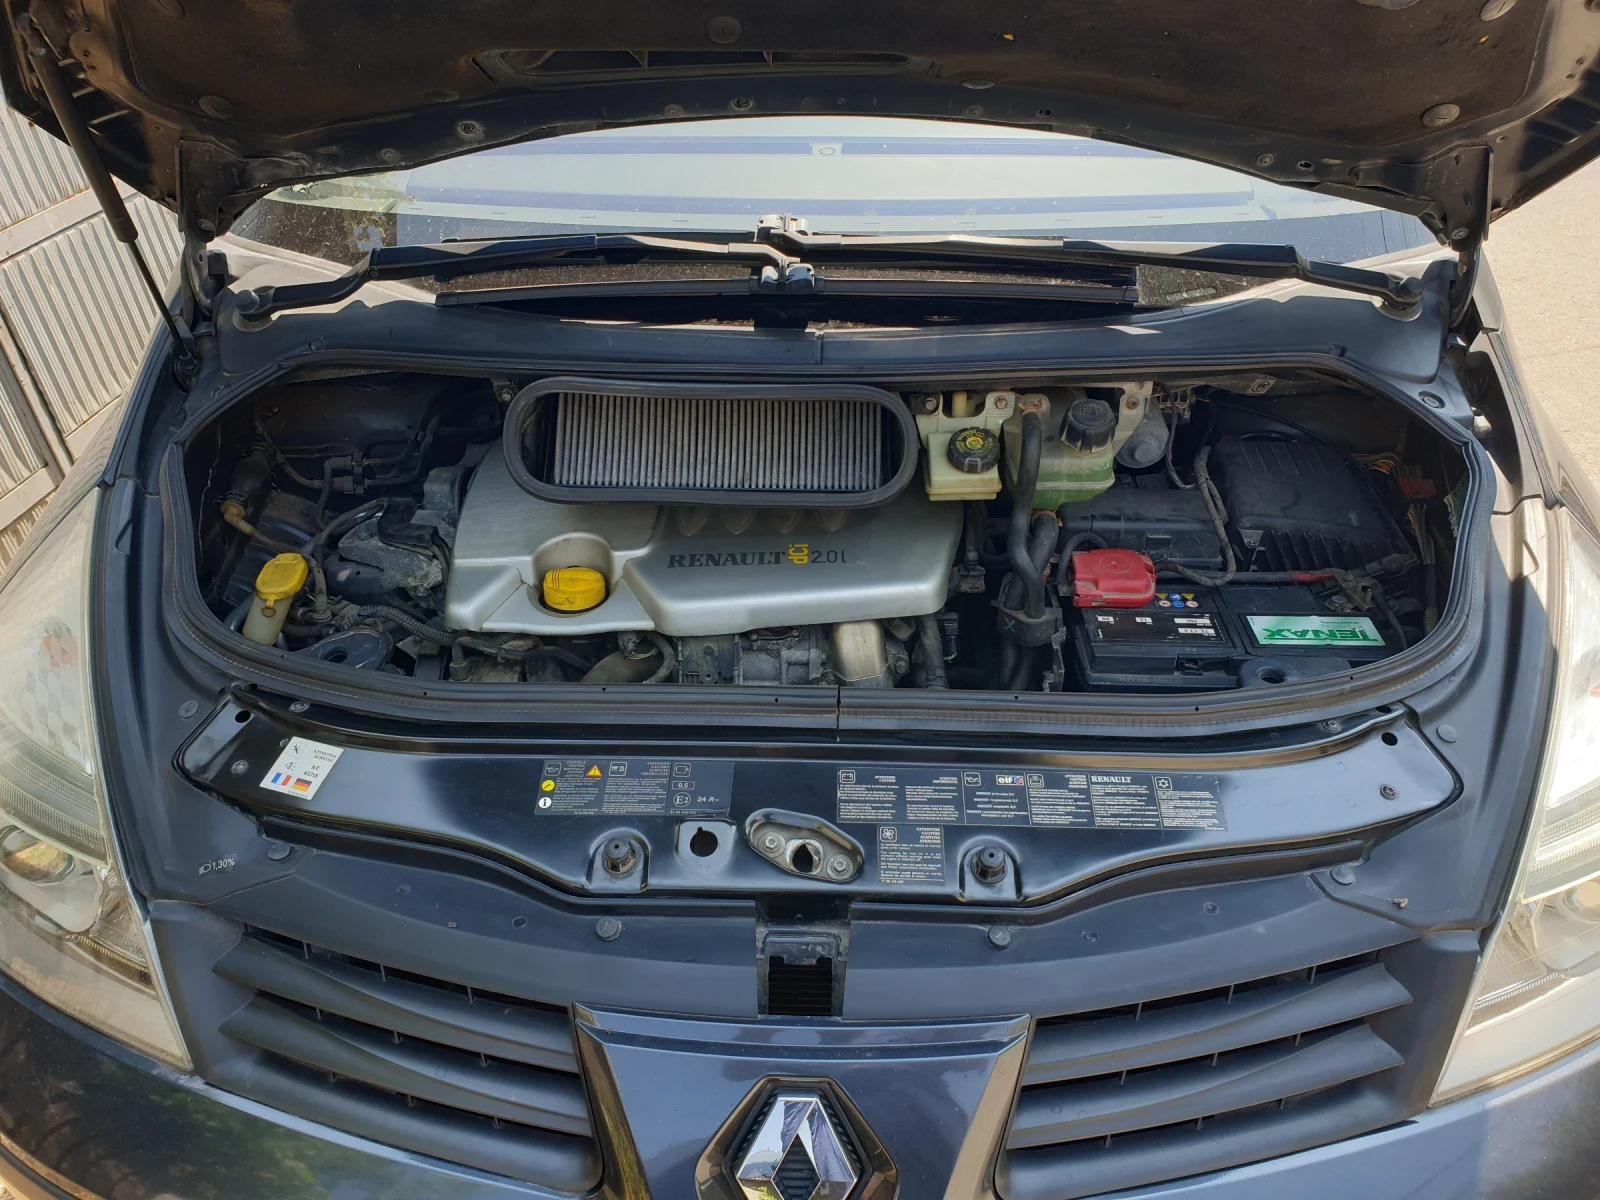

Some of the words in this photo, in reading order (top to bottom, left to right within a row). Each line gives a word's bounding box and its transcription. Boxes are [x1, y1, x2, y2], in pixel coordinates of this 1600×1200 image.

[667, 552, 785, 568] RENAULT
[788, 544, 808, 564] dCi
[1262, 629, 1378, 641] TENAX
[1091, 775, 1132, 783] RENAULT
[676, 796, 688, 804] E2
[213, 858, 235, 870] 1,30%
